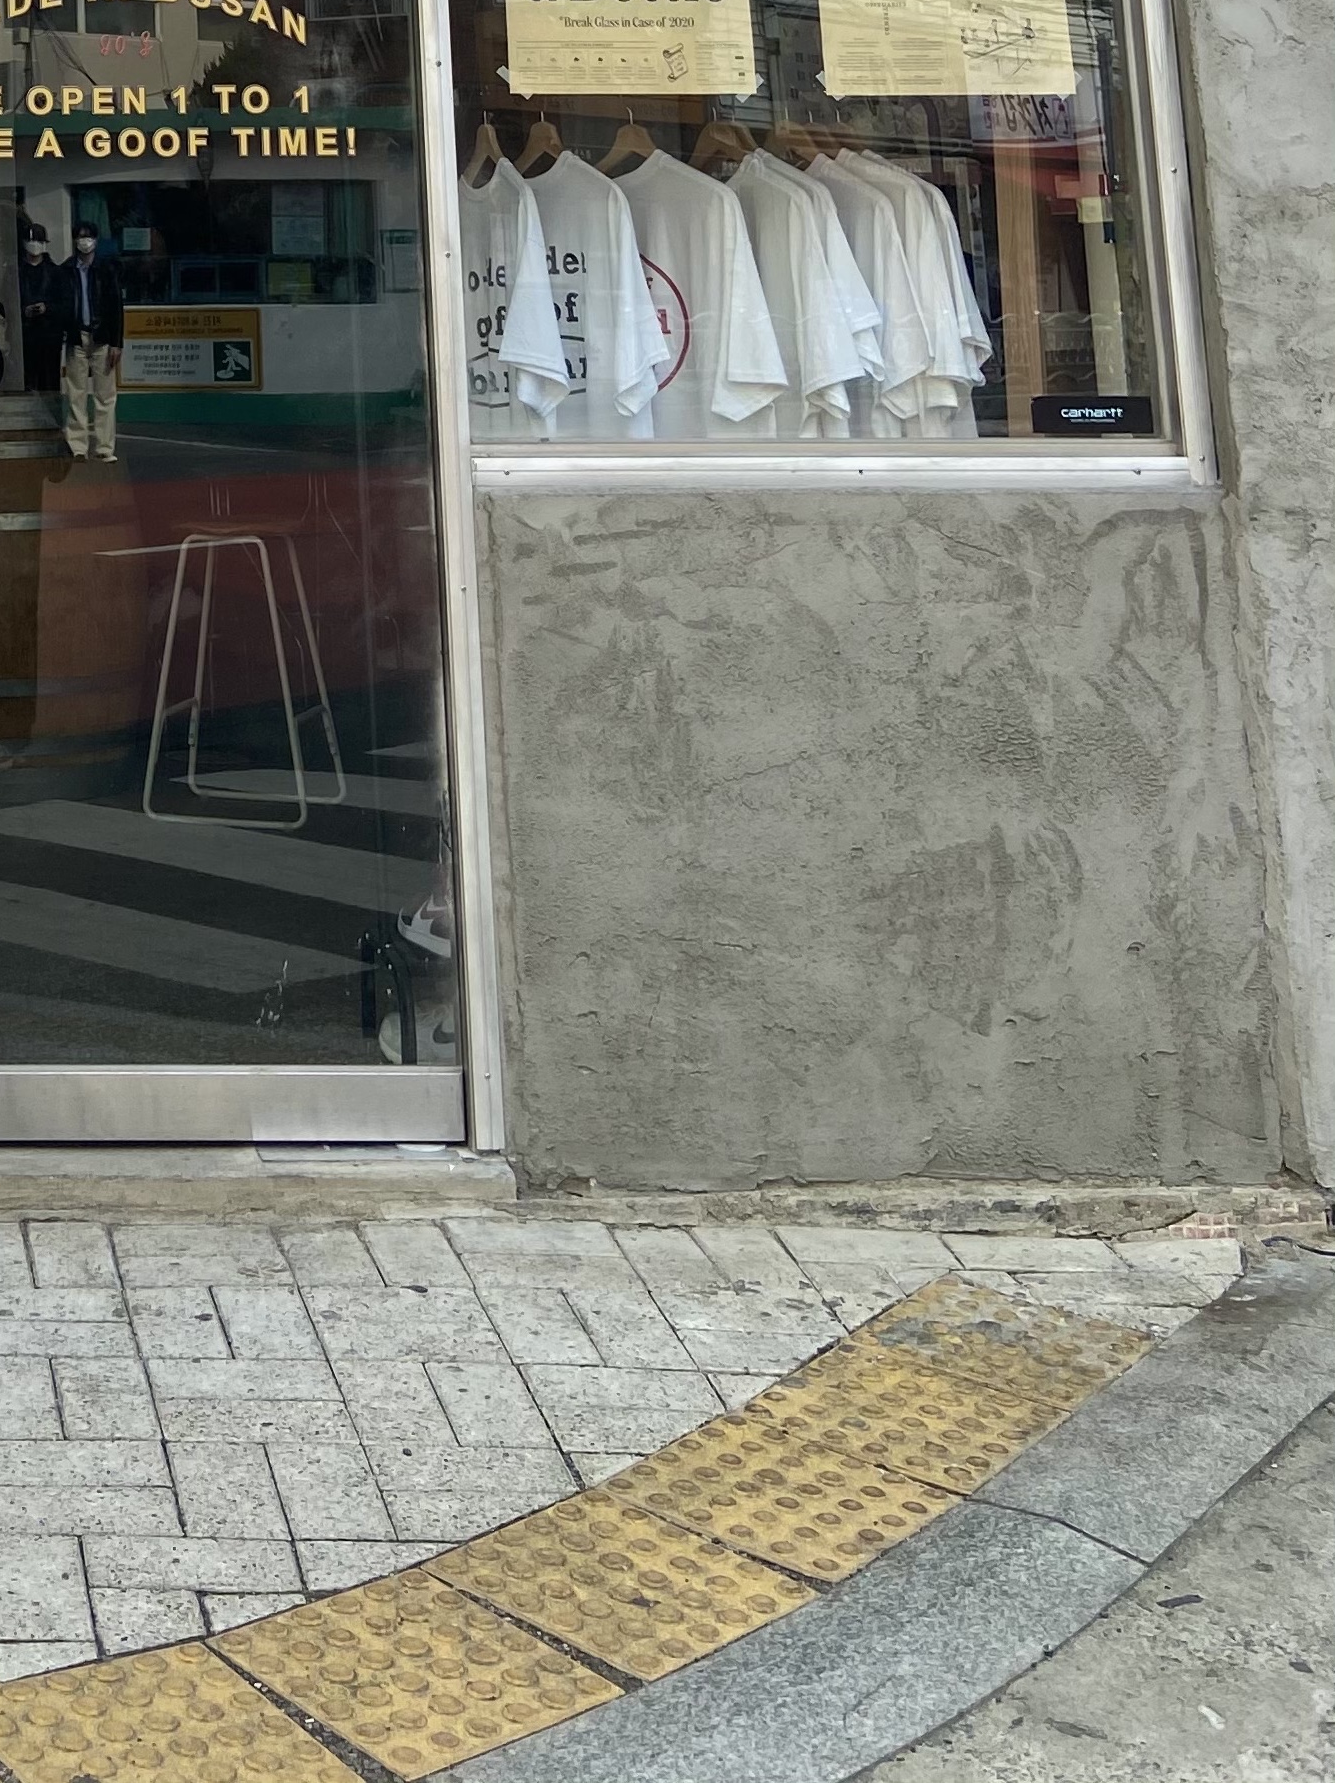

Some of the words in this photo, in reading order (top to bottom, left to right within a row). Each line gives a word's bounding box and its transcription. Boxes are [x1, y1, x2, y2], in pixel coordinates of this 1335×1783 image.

[594, 16, 620, 28] Glass
[621, 16, 631, 28] in
[632, 16, 655, 28] Case
[656, 16, 667, 28] of
[669, 16, 695, 28] 2020
[25, 84, 148, 116] OPEN
[169, 84, 190, 115] 1
[211, 84, 271, 115] TO
[293, 84, 311, 115] 1
[33, 126, 65, 159] A
[82, 126, 212, 159] GOOF
[230, 126, 358, 158] TIME!
[1060, 407, 1124, 418] carhartt
